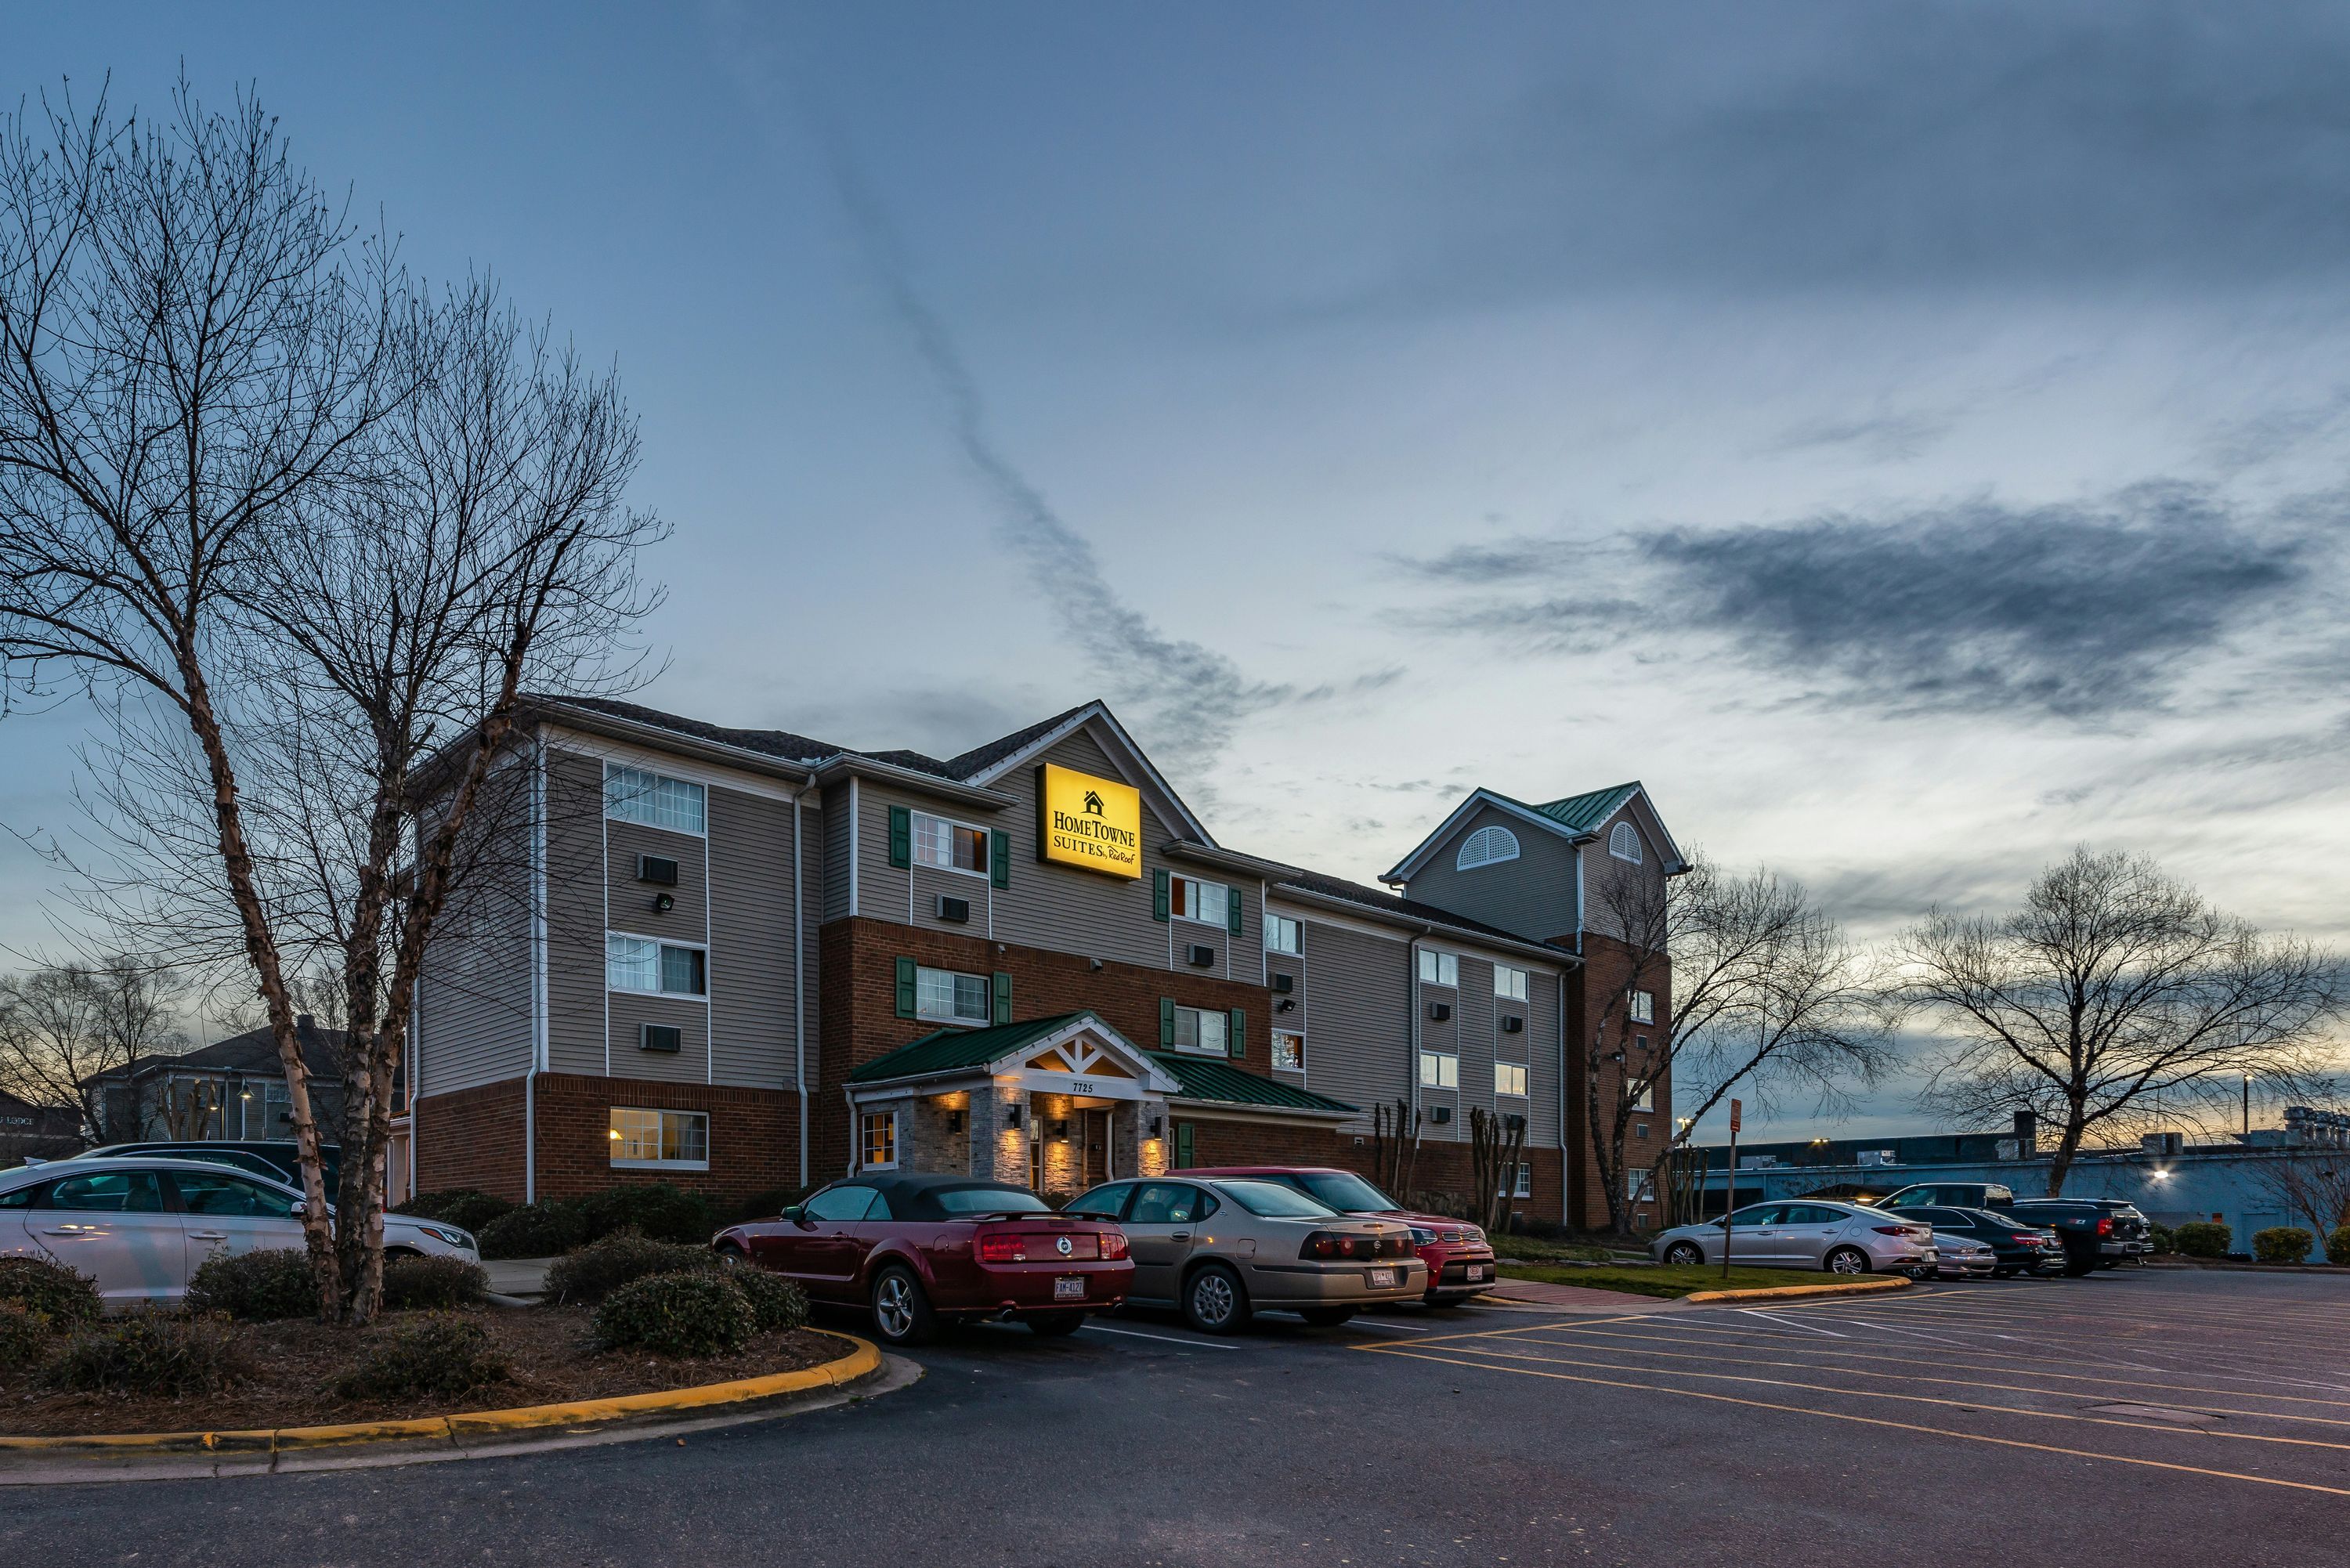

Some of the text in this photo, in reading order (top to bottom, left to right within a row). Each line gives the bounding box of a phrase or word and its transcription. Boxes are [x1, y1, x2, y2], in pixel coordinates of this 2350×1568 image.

[1054, 835, 1103, 857] SUITES
[1103, 851, 1108, 859] by
[1073, 1082, 1094, 1093] 7725
[1056, 1282, 1083, 1293] FAM-4127
